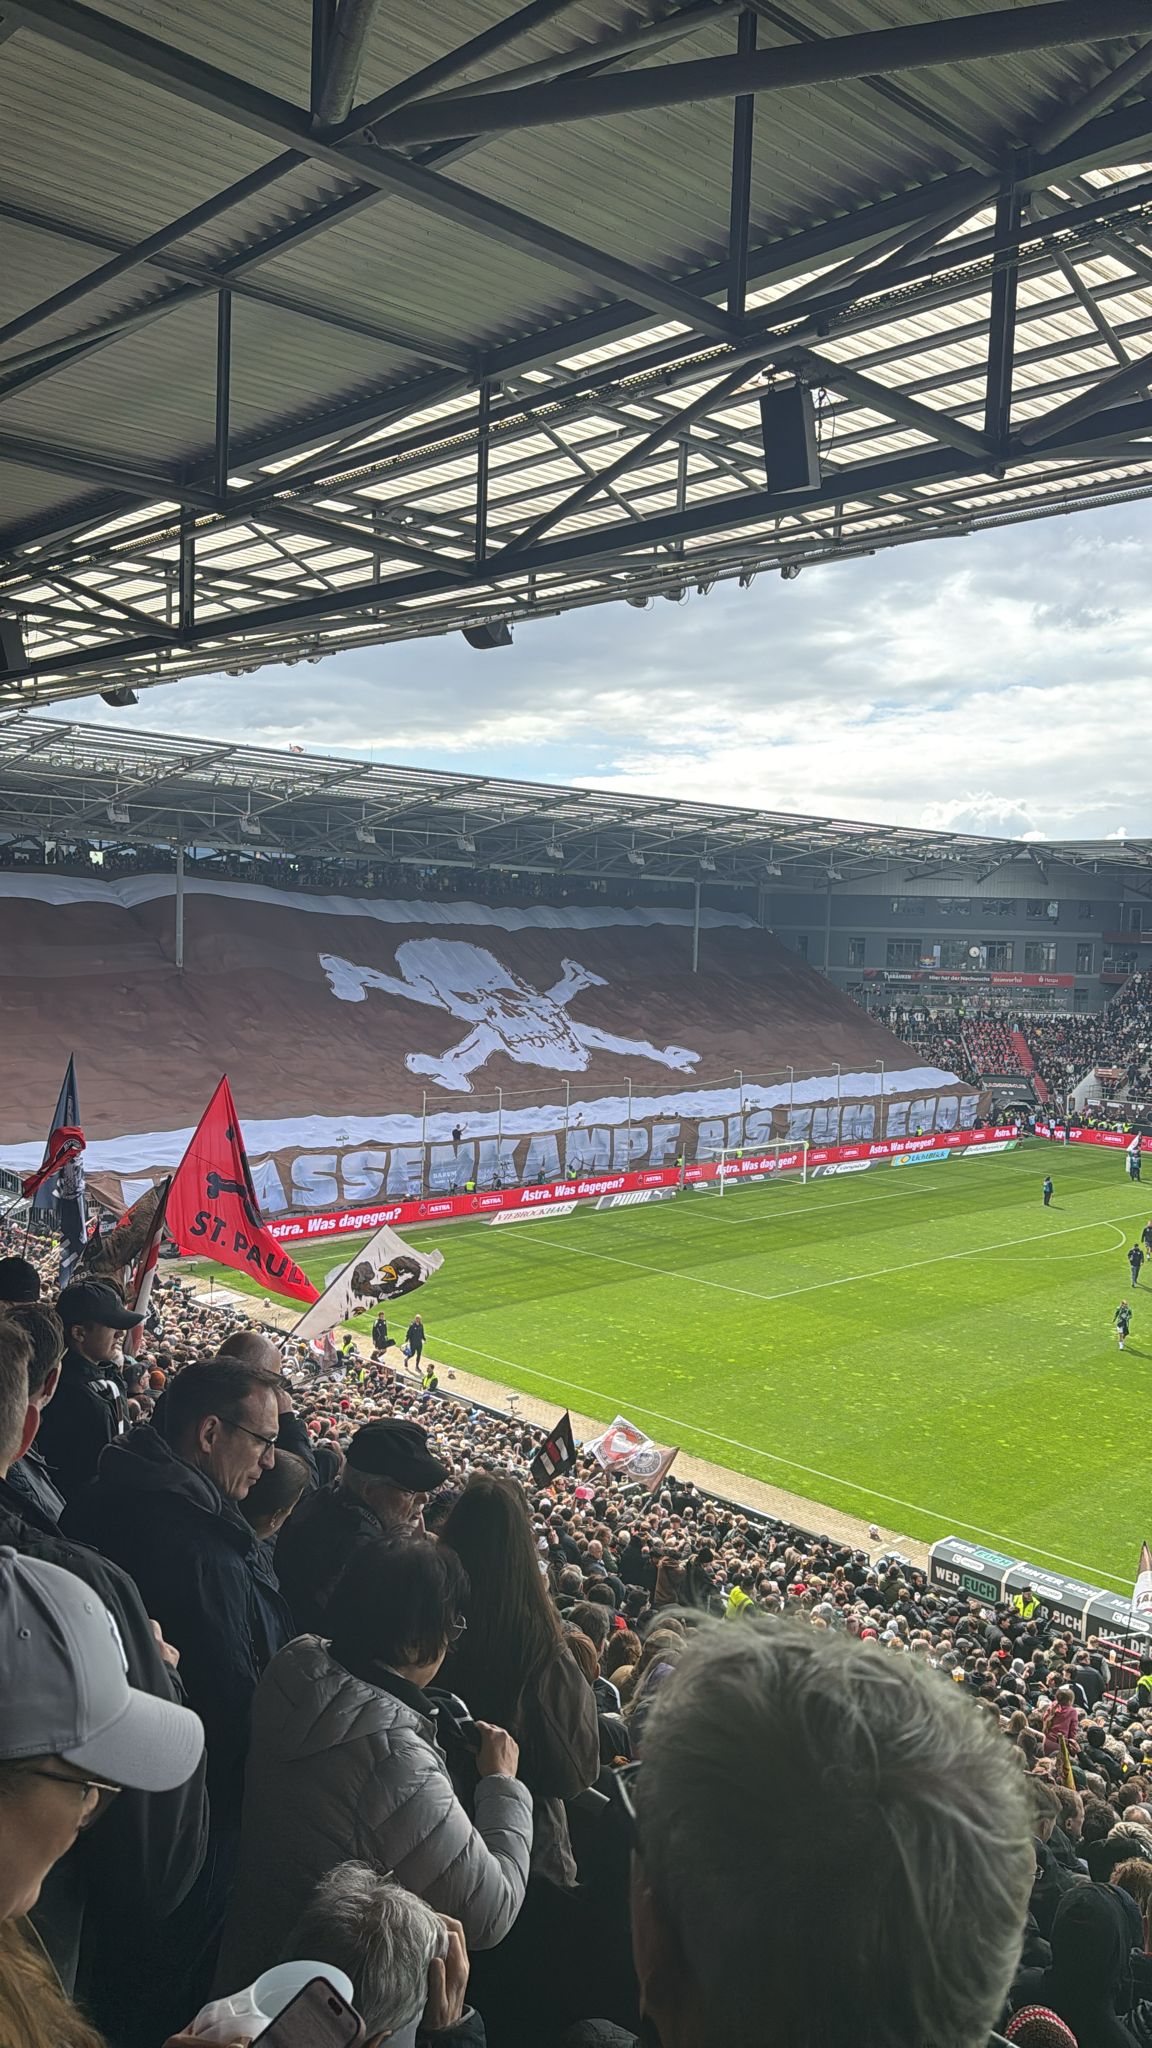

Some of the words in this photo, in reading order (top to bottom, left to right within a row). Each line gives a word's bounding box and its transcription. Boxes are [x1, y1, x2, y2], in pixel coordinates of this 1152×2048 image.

[869, 1145, 888, 1154] Astra.
[891, 1142, 905, 1151] Was
[905, 1138, 935, 1150] dagegen?
[742, 1159, 758, 1171] Was
[521, 1190, 552, 1202] Astra.
[555, 1185, 575, 1197] Was
[577, 1178, 625, 1194] dagegen?
[610, 1190, 652, 1207] PUMA
[430, 1204, 450, 1212] ASTRA
[481, 1197, 501, 1205] ASTRA
[307, 1218, 336, 1232] Was
[338, 1208, 402, 1228] dagegen?
[497, 1204, 574, 1221] VIEBROCKHAUS
[190, 1211, 226, 1246] ST.
[977, 1551, 1011, 1566] EUCH
[935, 1566, 960, 1586] WER
[964, 1578, 995, 1598] EUCH
[1018, 1566, 1064, 1587] HINTER
[1065, 1583, 1097, 1597] SICH
[1053, 1610, 1081, 1631] SICH
